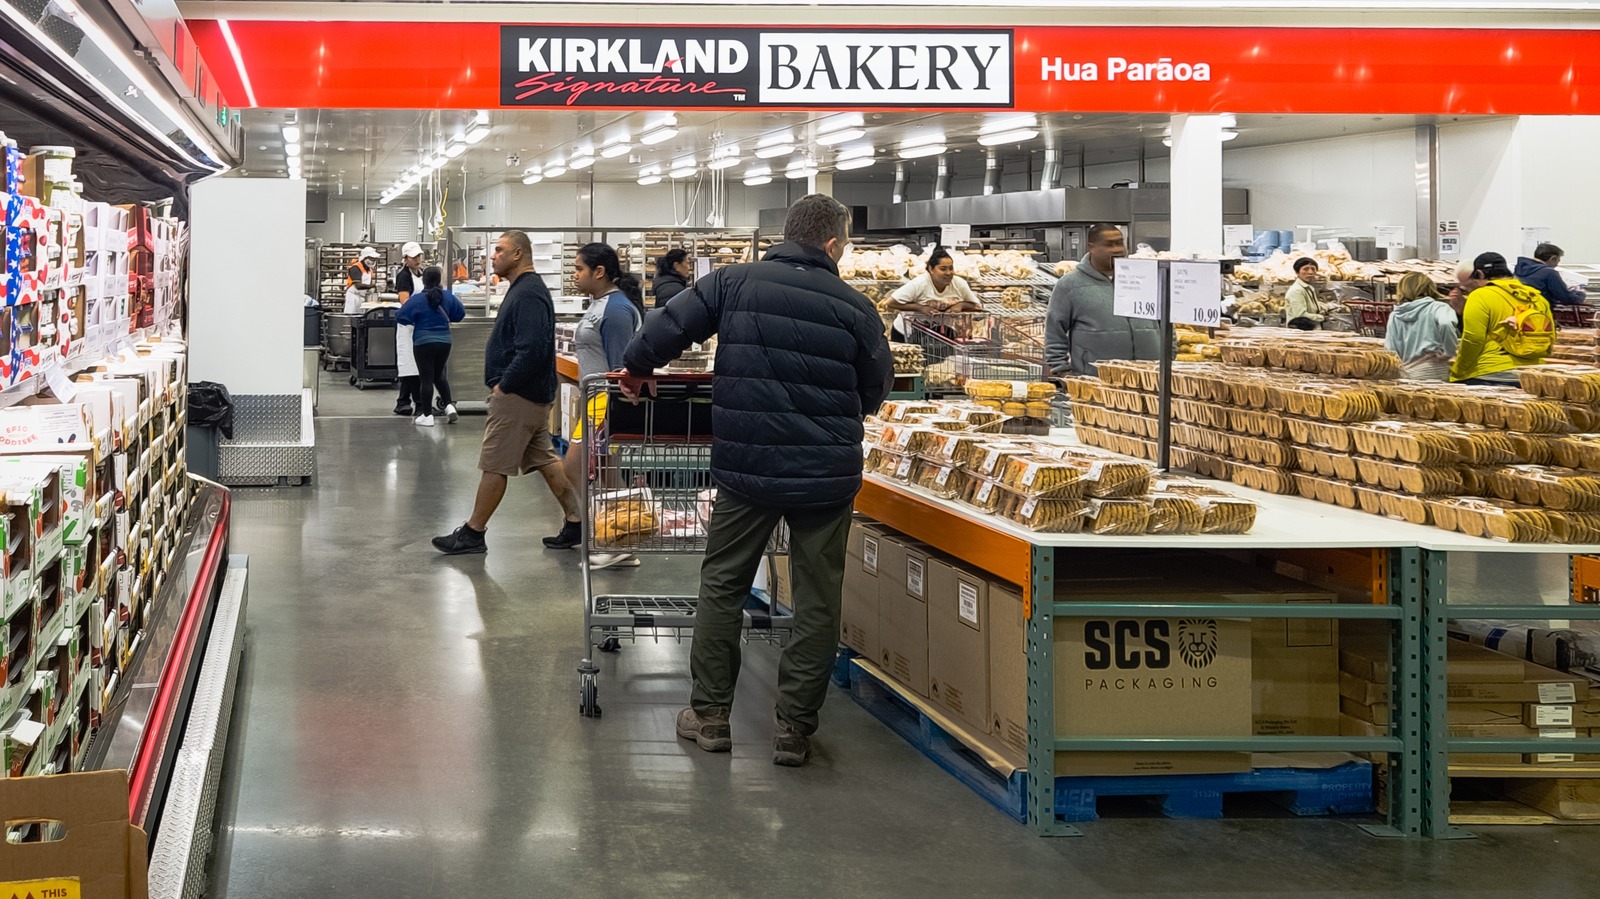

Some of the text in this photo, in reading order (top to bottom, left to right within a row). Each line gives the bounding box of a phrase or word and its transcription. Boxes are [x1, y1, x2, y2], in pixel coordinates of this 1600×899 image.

[518, 37, 749, 73] KIRKLAND
[767, 44, 1001, 90] BAKERY
[1041, 57, 1211, 81] Hua Parāoa
[515, 72, 746, 105] Signature
[1133, 301, 1156, 316] 13.98
[1193, 308, 1219, 323] 10.99
[6, 426, 28, 434] EPIC
[1084, 619, 1171, 670] SCS
[1085, 676, 1218, 690] PACKAGING
[41, 888, 67, 898] THIS
